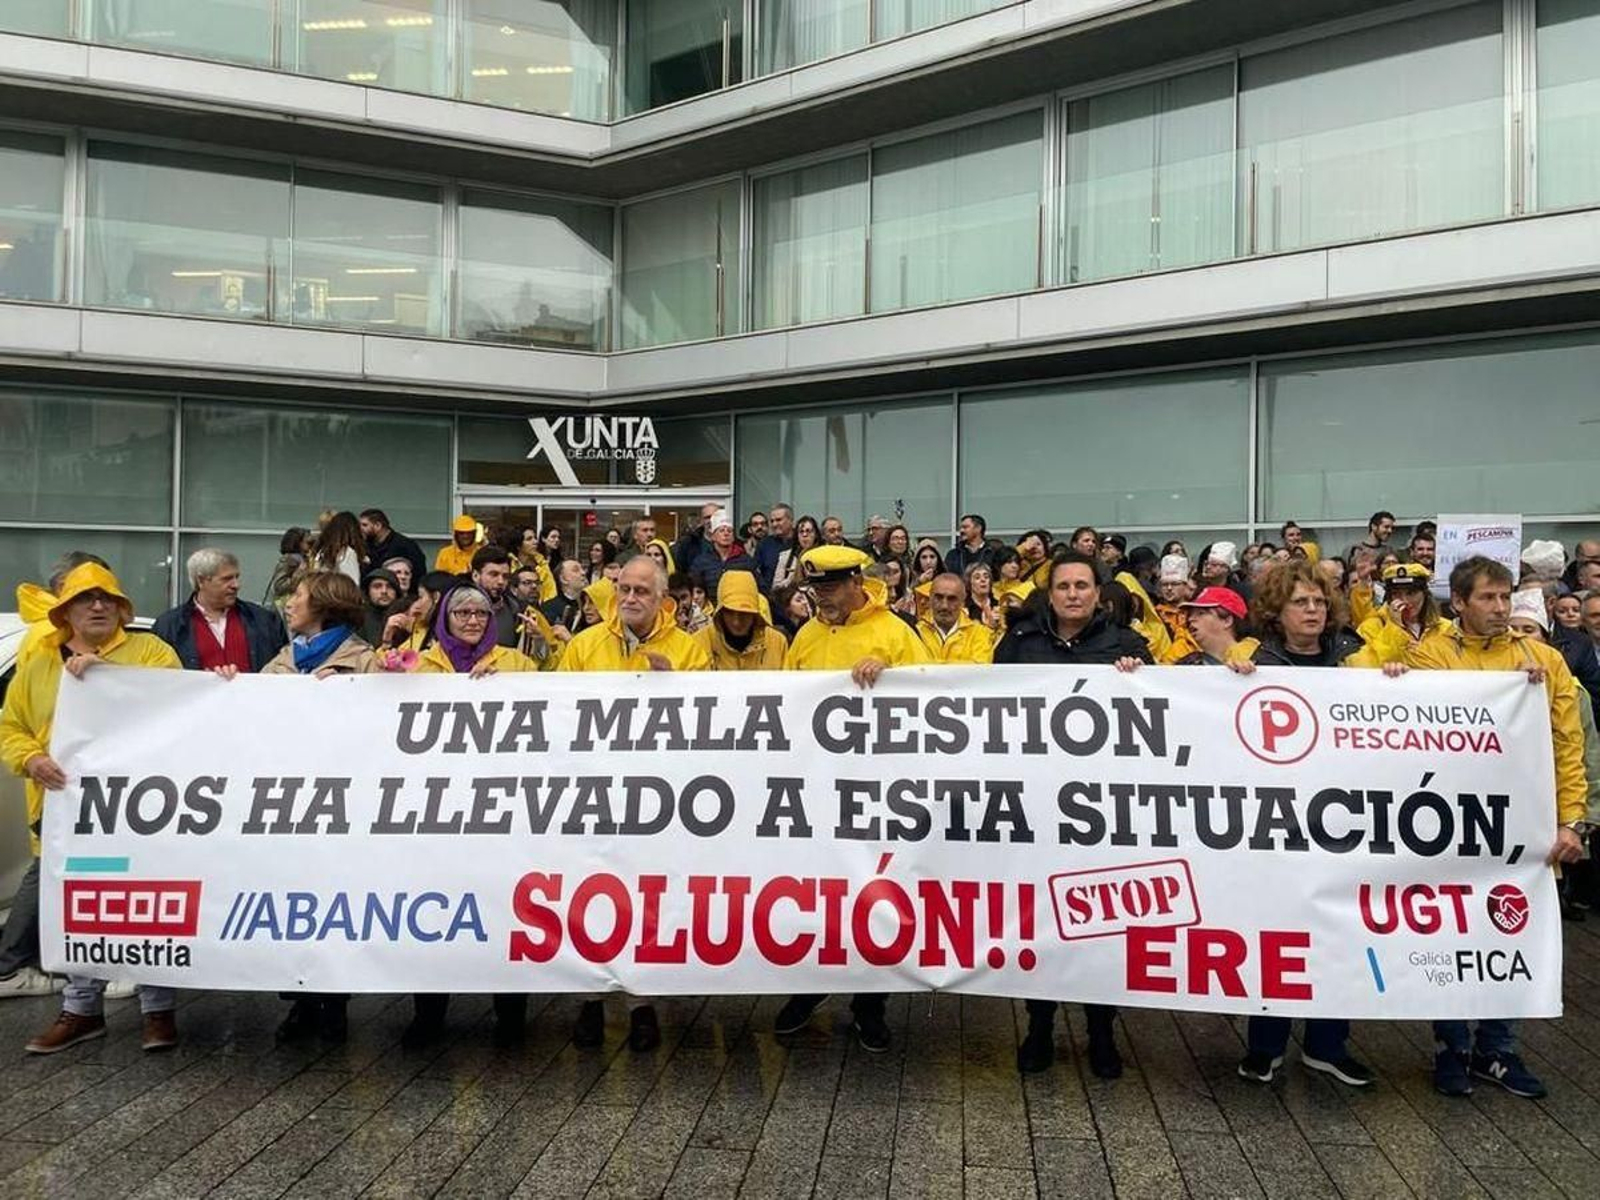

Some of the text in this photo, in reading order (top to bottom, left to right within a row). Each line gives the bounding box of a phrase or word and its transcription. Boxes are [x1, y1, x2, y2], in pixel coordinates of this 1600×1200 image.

[526, 415, 660, 487] XUNTA
[396, 679, 1191, 768] UNA MALA GESTIÓN,
[1329, 703, 1496, 726] GRUPO NUEVA
[1334, 727, 1504, 754] PESCANOVA
[75, 772, 1526, 866] NOS HA LLEVADO A ESTA SITUACIÓN,
[70, 889, 189, 924] CCOO
[508, 853, 1037, 972] SOLUCIÓN!!
[1065, 876, 1181, 926] STOP
[1359, 883, 1474, 935] UGT
[64, 936, 192, 969] industria
[1126, 926, 1314, 1000] ERE
[1408, 951, 1453, 967] Galicia
[1455, 949, 1533, 983] FICA
[1426, 969, 1454, 987] Vigo
